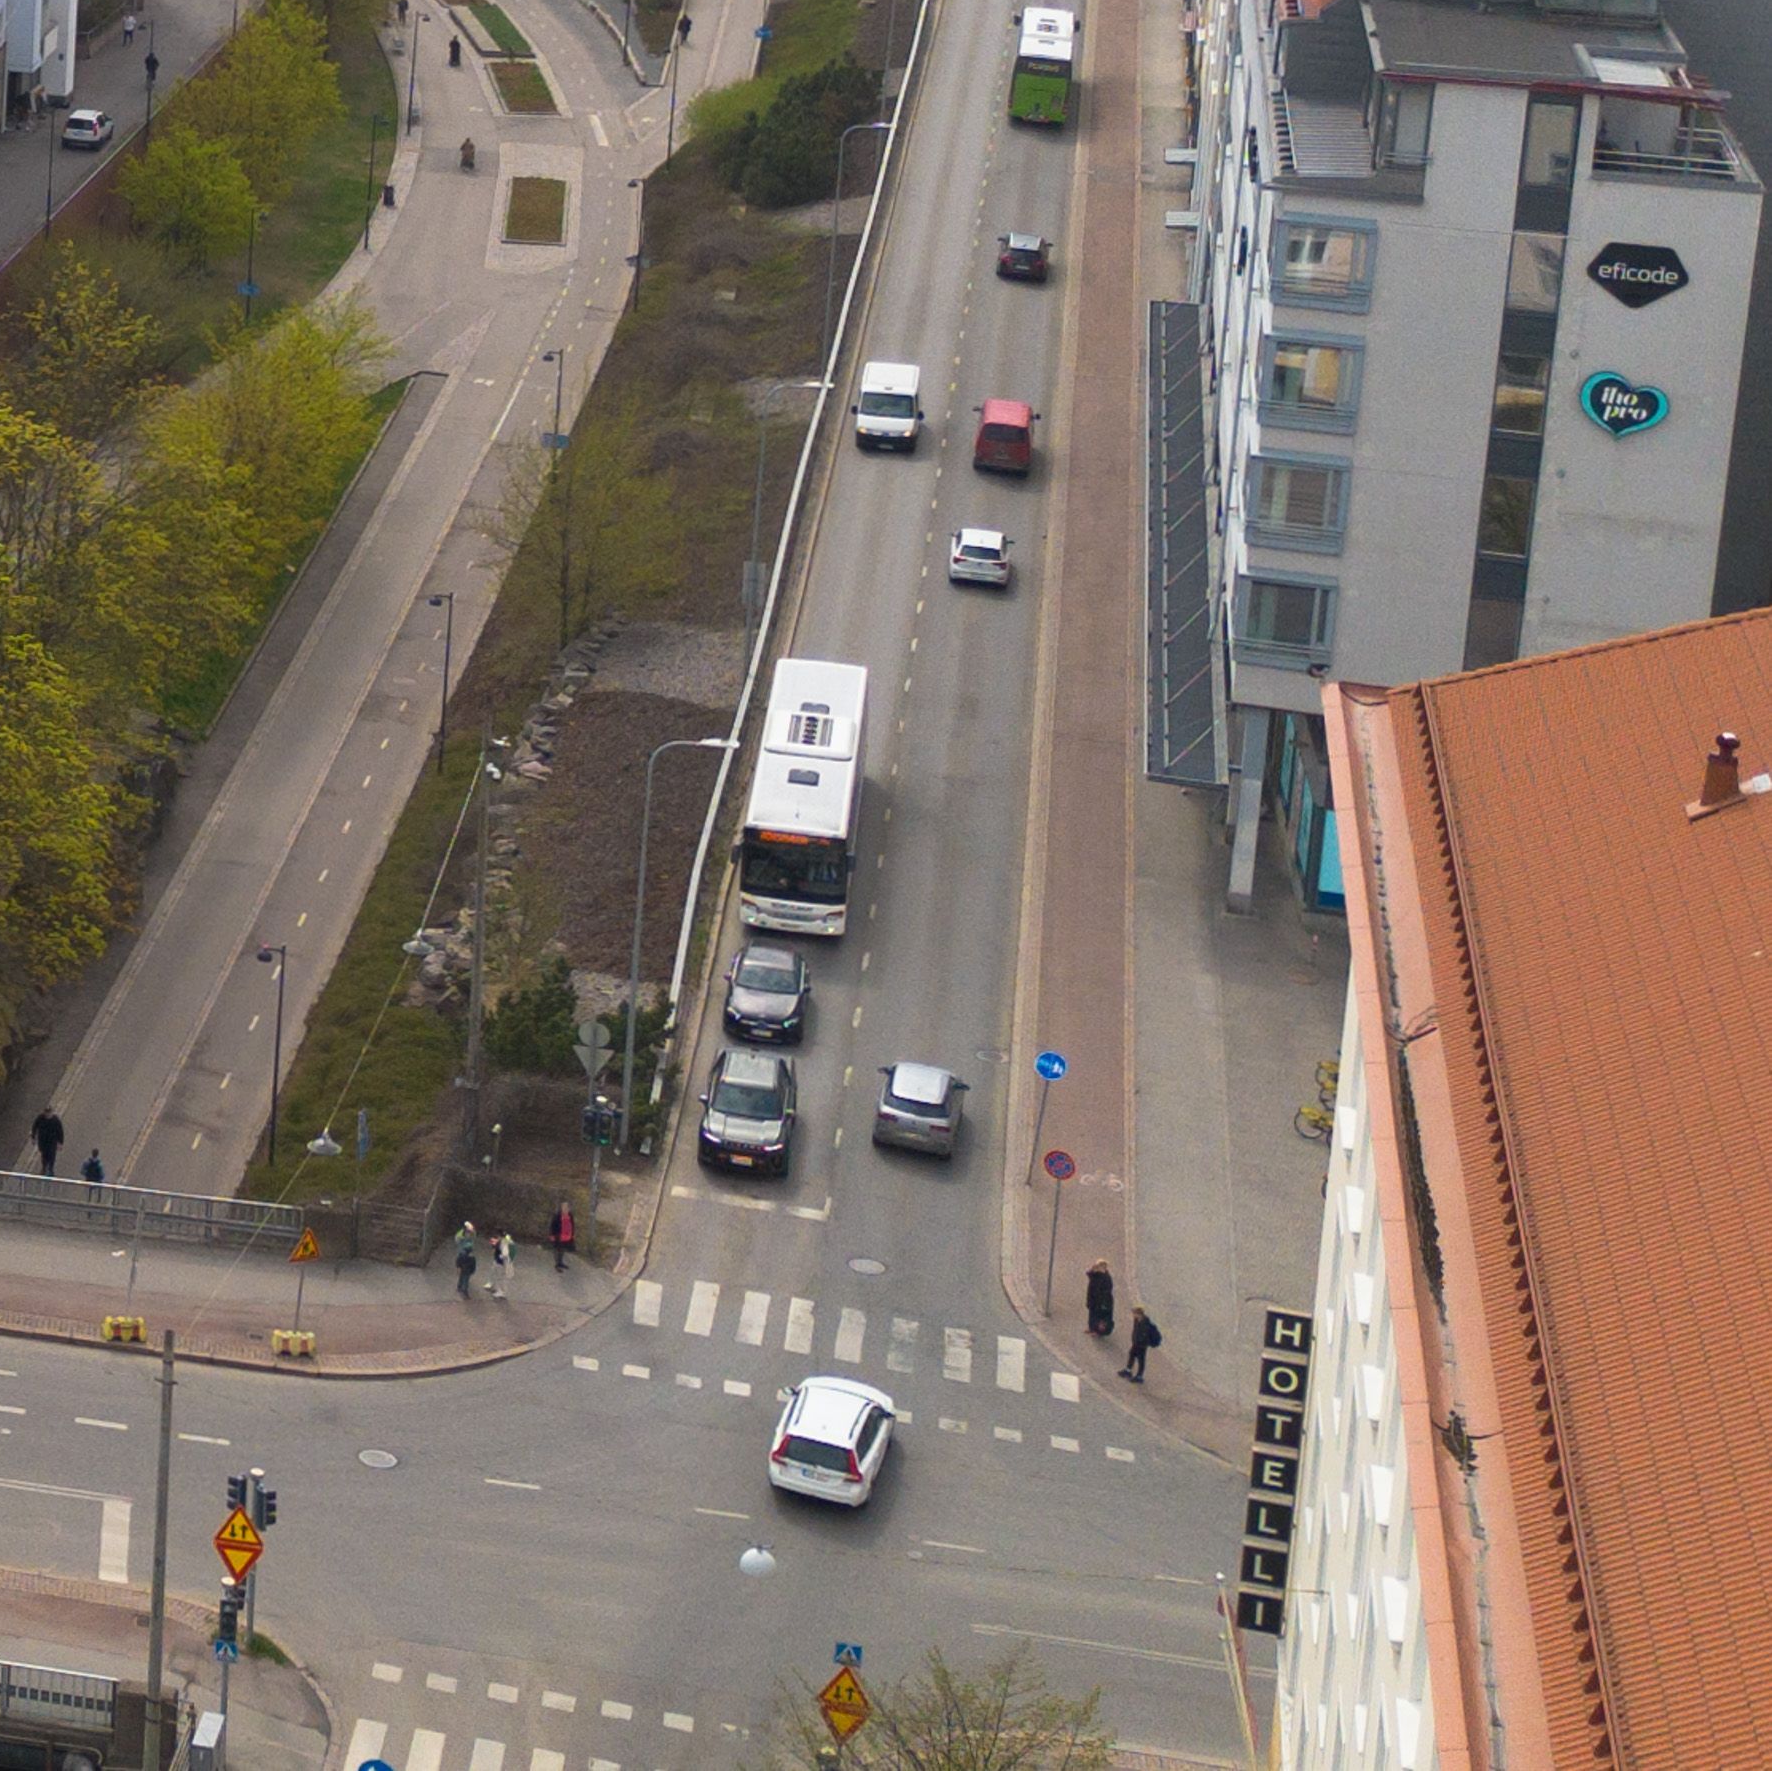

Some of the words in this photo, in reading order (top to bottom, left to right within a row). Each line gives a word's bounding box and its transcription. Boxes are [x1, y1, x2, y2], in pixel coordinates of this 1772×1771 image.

[1598, 261, 1679, 286] eficode
[1601, 386, 1639, 407] iho
[1602, 404, 1648, 422] pro
[1254, 1317, 1302, 1628] HOTELLI
